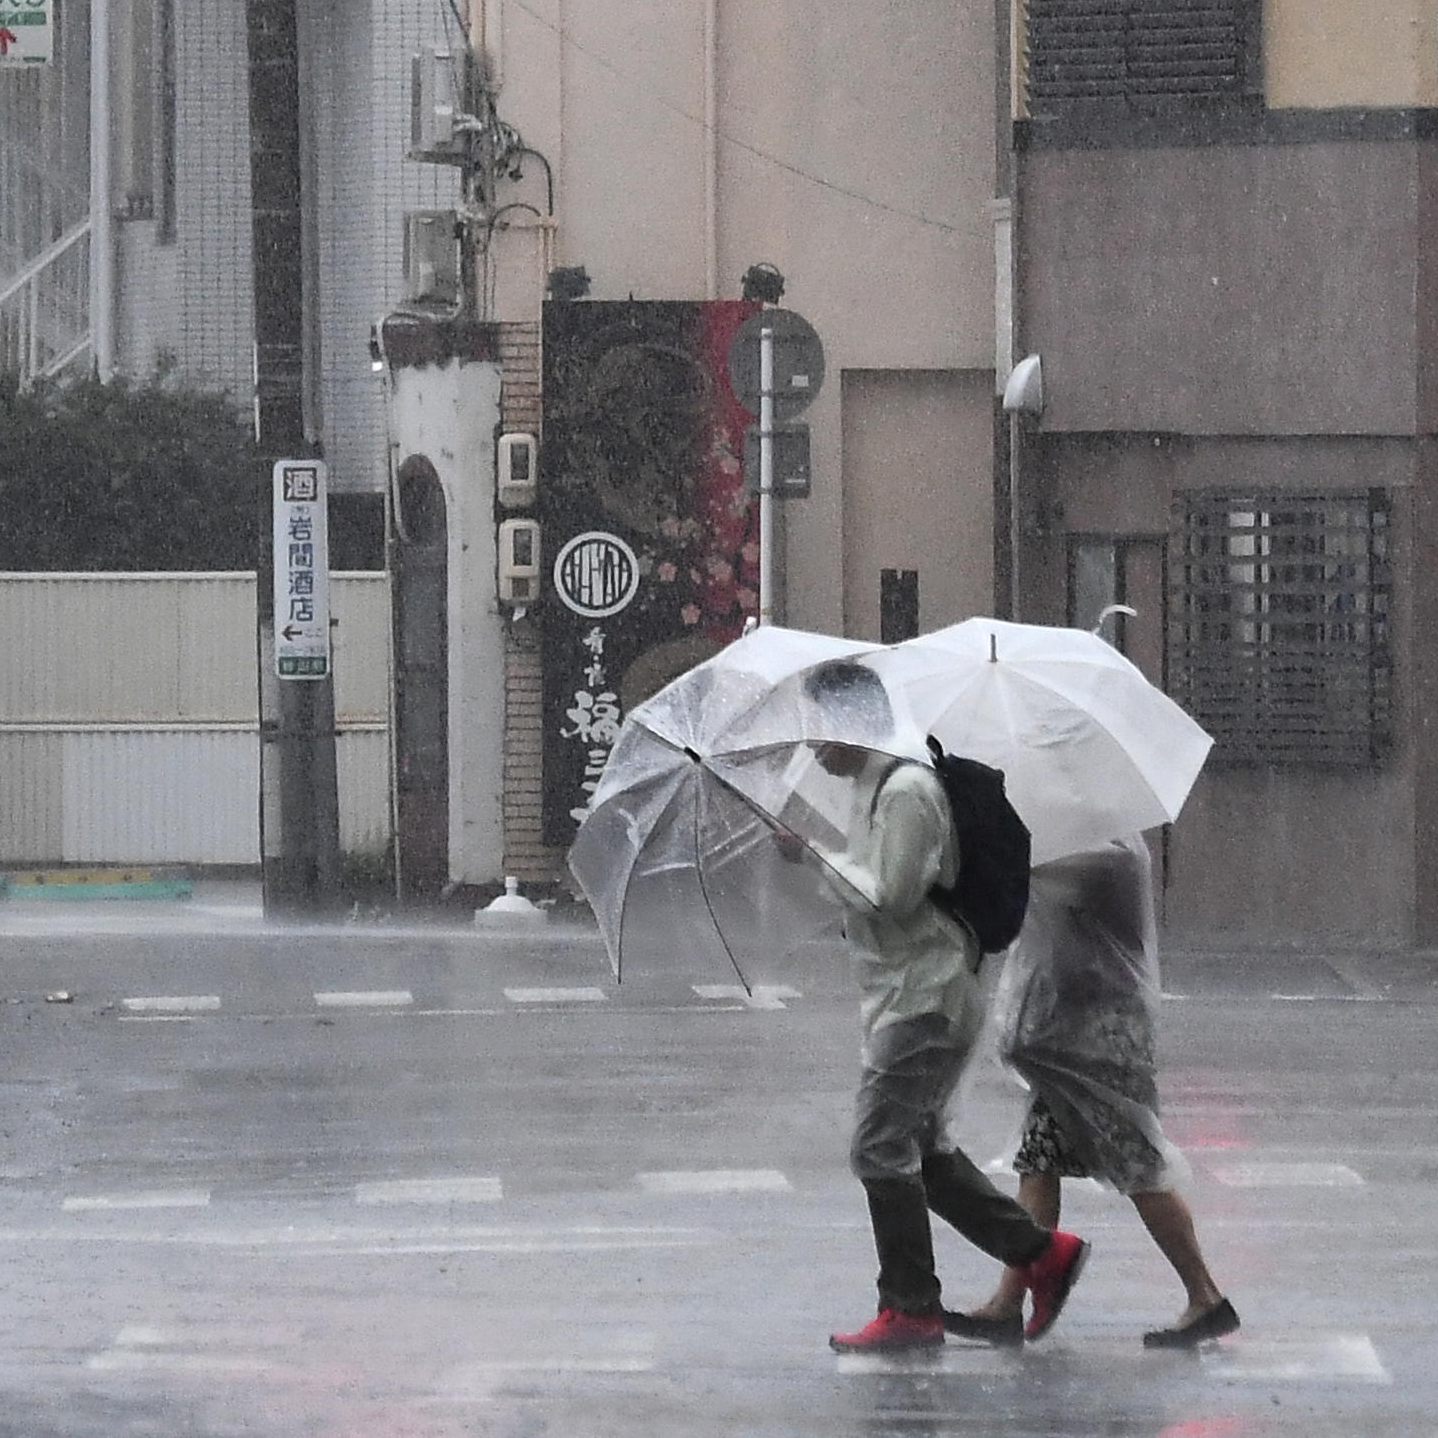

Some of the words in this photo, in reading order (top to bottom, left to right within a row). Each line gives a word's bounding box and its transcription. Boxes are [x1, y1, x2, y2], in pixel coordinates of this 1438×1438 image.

[284, 468, 317, 501] 酒
[288, 517, 314, 622] 岩間酒店
